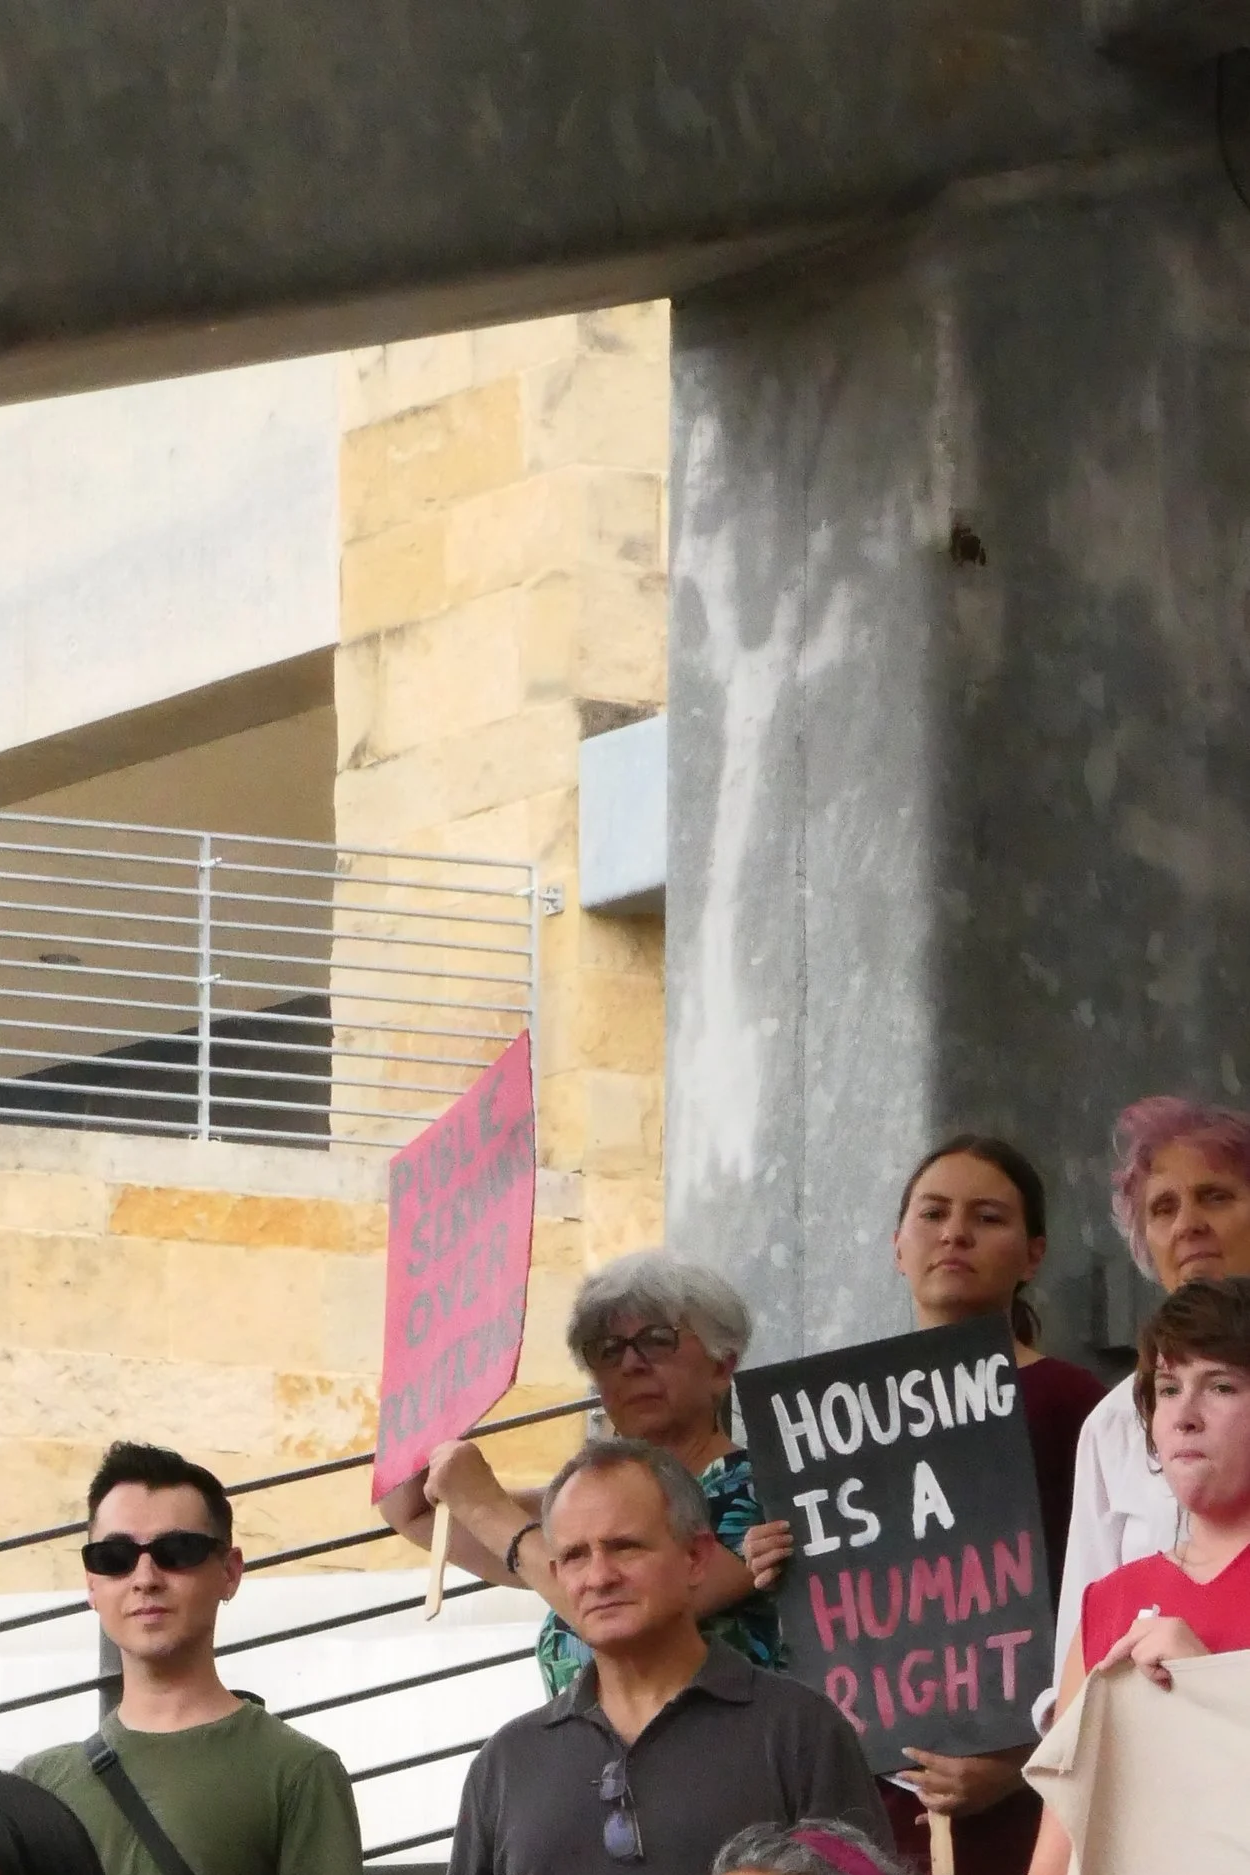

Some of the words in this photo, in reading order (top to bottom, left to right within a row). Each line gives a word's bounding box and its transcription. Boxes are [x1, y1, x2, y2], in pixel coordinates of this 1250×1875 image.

[405, 1220, 509, 1348] OVER
[770, 1352, 1017, 1474] HOUSING
[792, 1477, 882, 1558] IS
[911, 1459, 956, 1541] A
[808, 1530, 1035, 1653] HUMAN
[823, 1629, 1034, 1736] RIGHT
